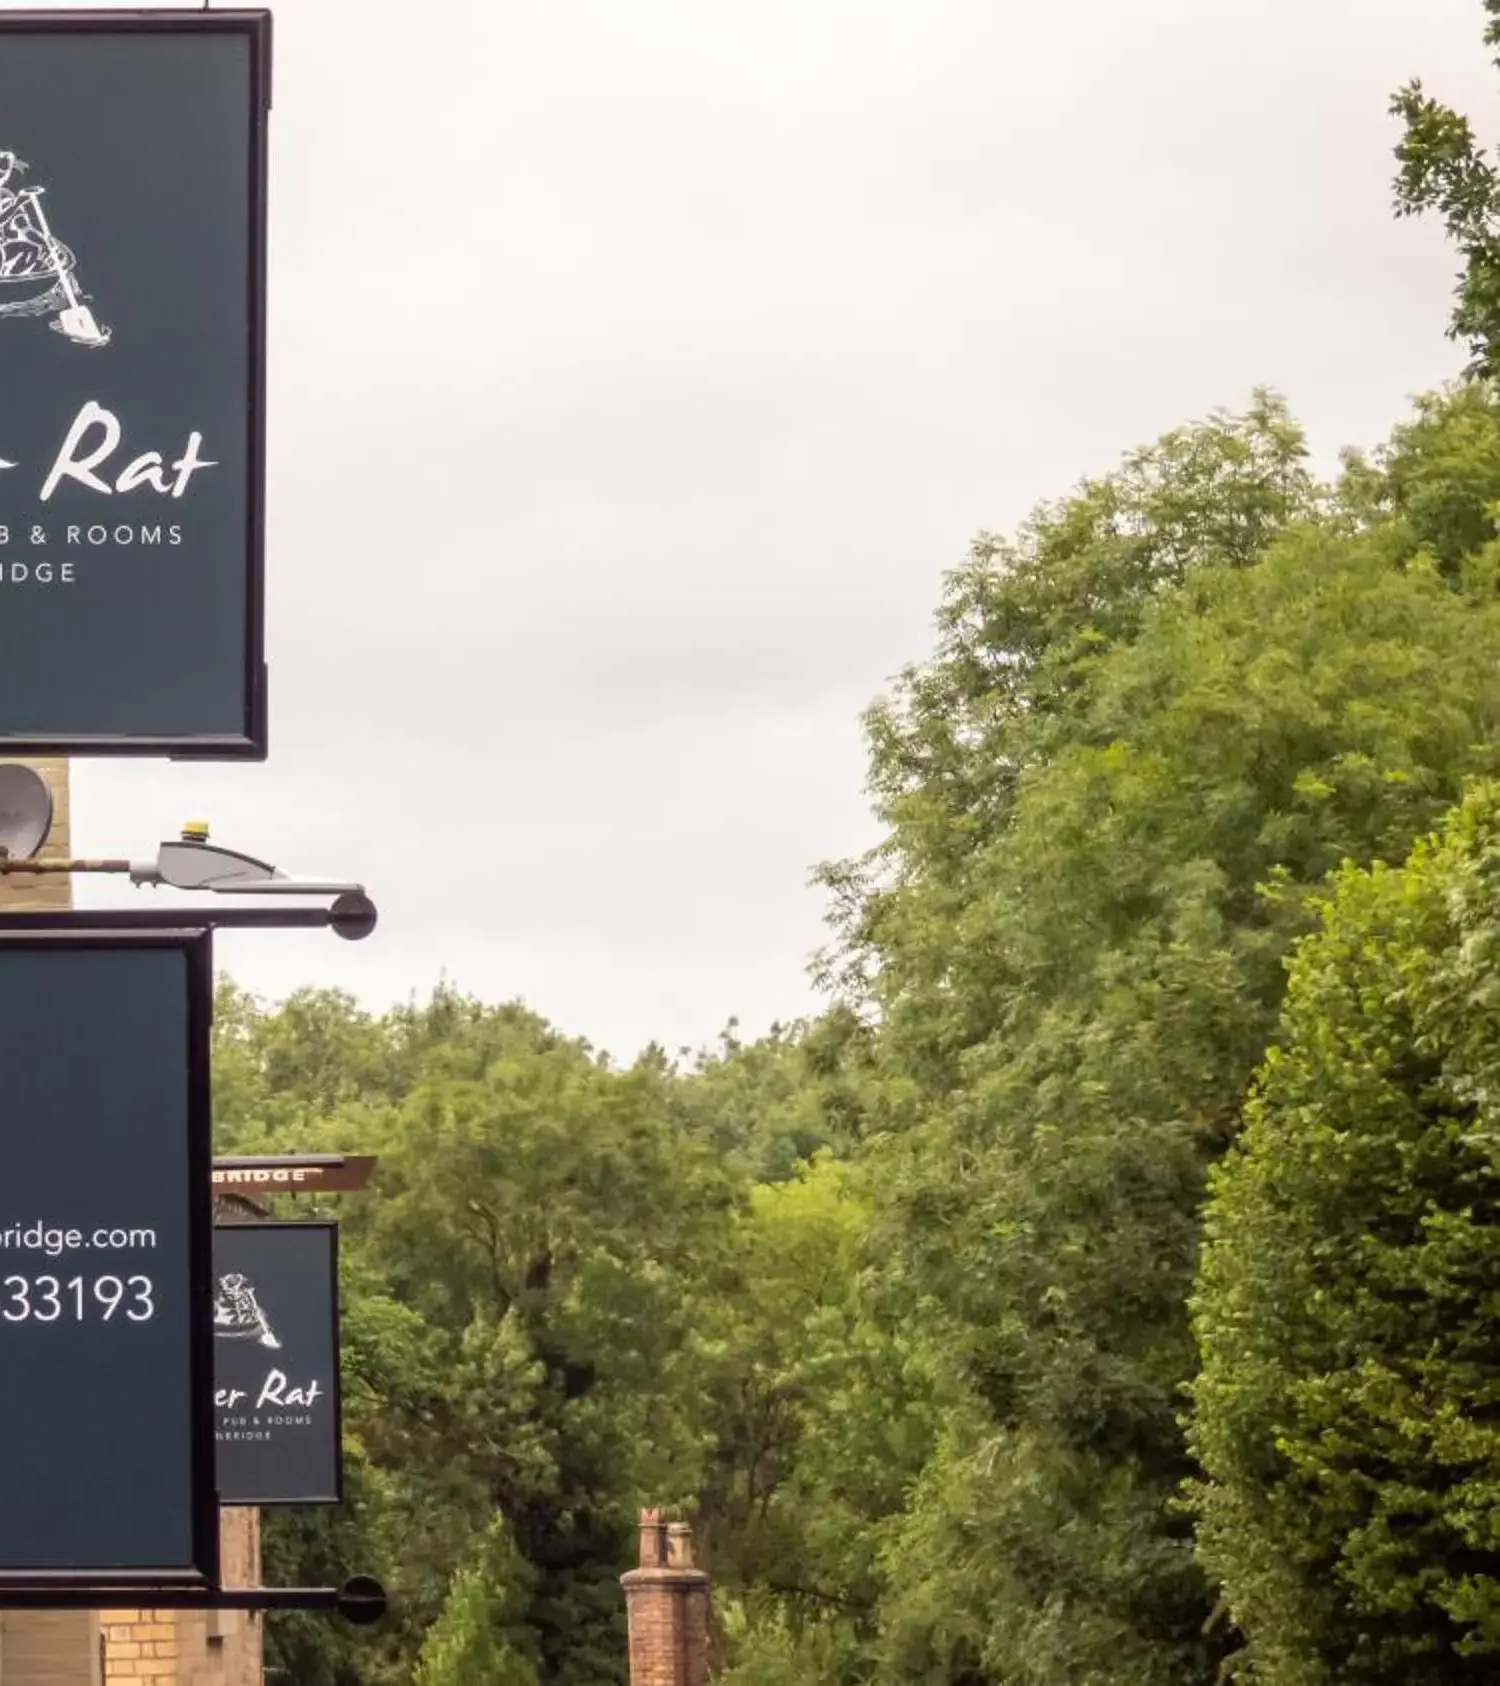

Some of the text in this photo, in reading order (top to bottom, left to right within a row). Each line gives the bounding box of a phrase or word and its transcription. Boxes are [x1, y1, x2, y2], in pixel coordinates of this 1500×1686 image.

[39, 399, 220, 502] Rat
[29, 525, 48, 545] &
[67, 525, 184, 545] ROOMS
[211, 1168, 306, 1183] BRIDGE
[214, 1367, 324, 1409] er Rat
